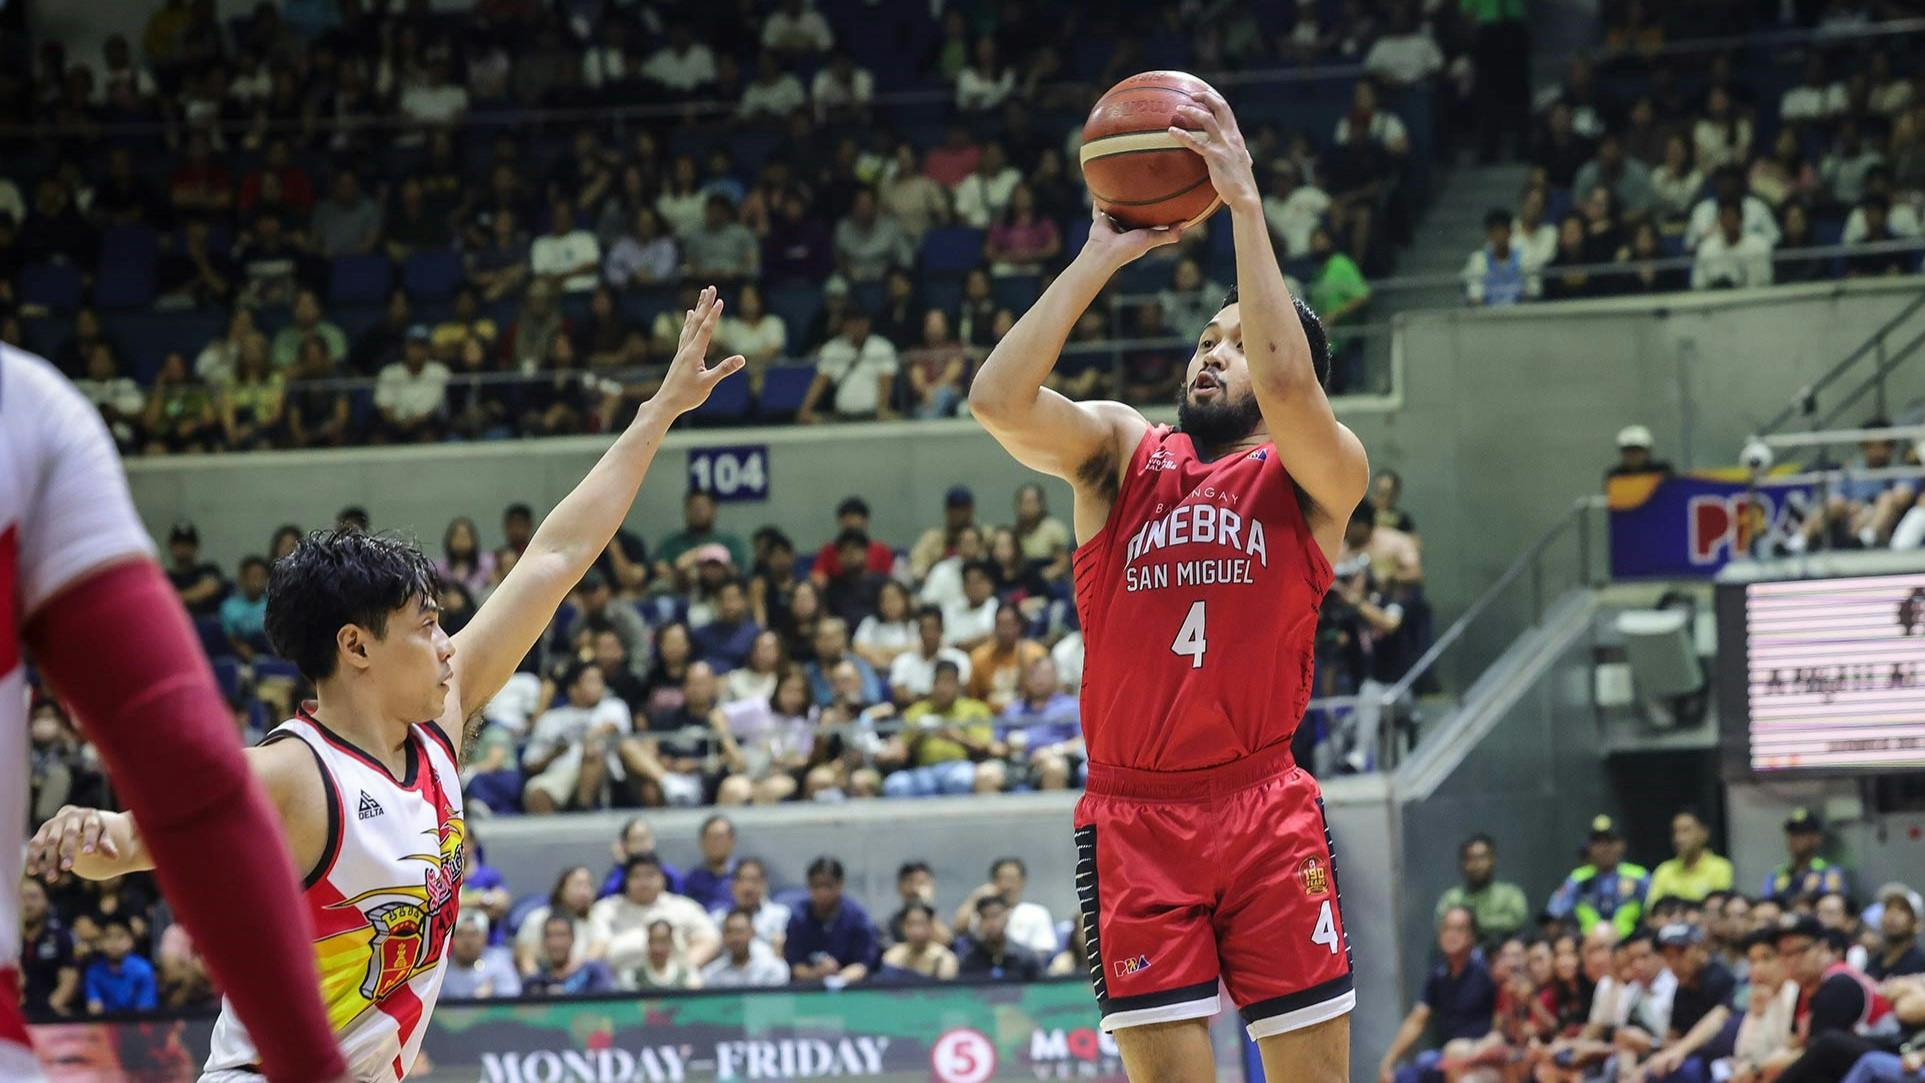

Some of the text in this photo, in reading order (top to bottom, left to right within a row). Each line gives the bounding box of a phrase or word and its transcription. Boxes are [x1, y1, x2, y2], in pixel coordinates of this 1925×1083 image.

[691, 452, 765, 494] 104
[1126, 559, 1254, 593] SAN MIGUEL
[1170, 600, 1207, 669] 4
[359, 807, 384, 820] DELTA
[1310, 899, 1339, 955] 4
[1114, 954, 1152, 978] PBA
[952, 1041, 977, 1076] 5
